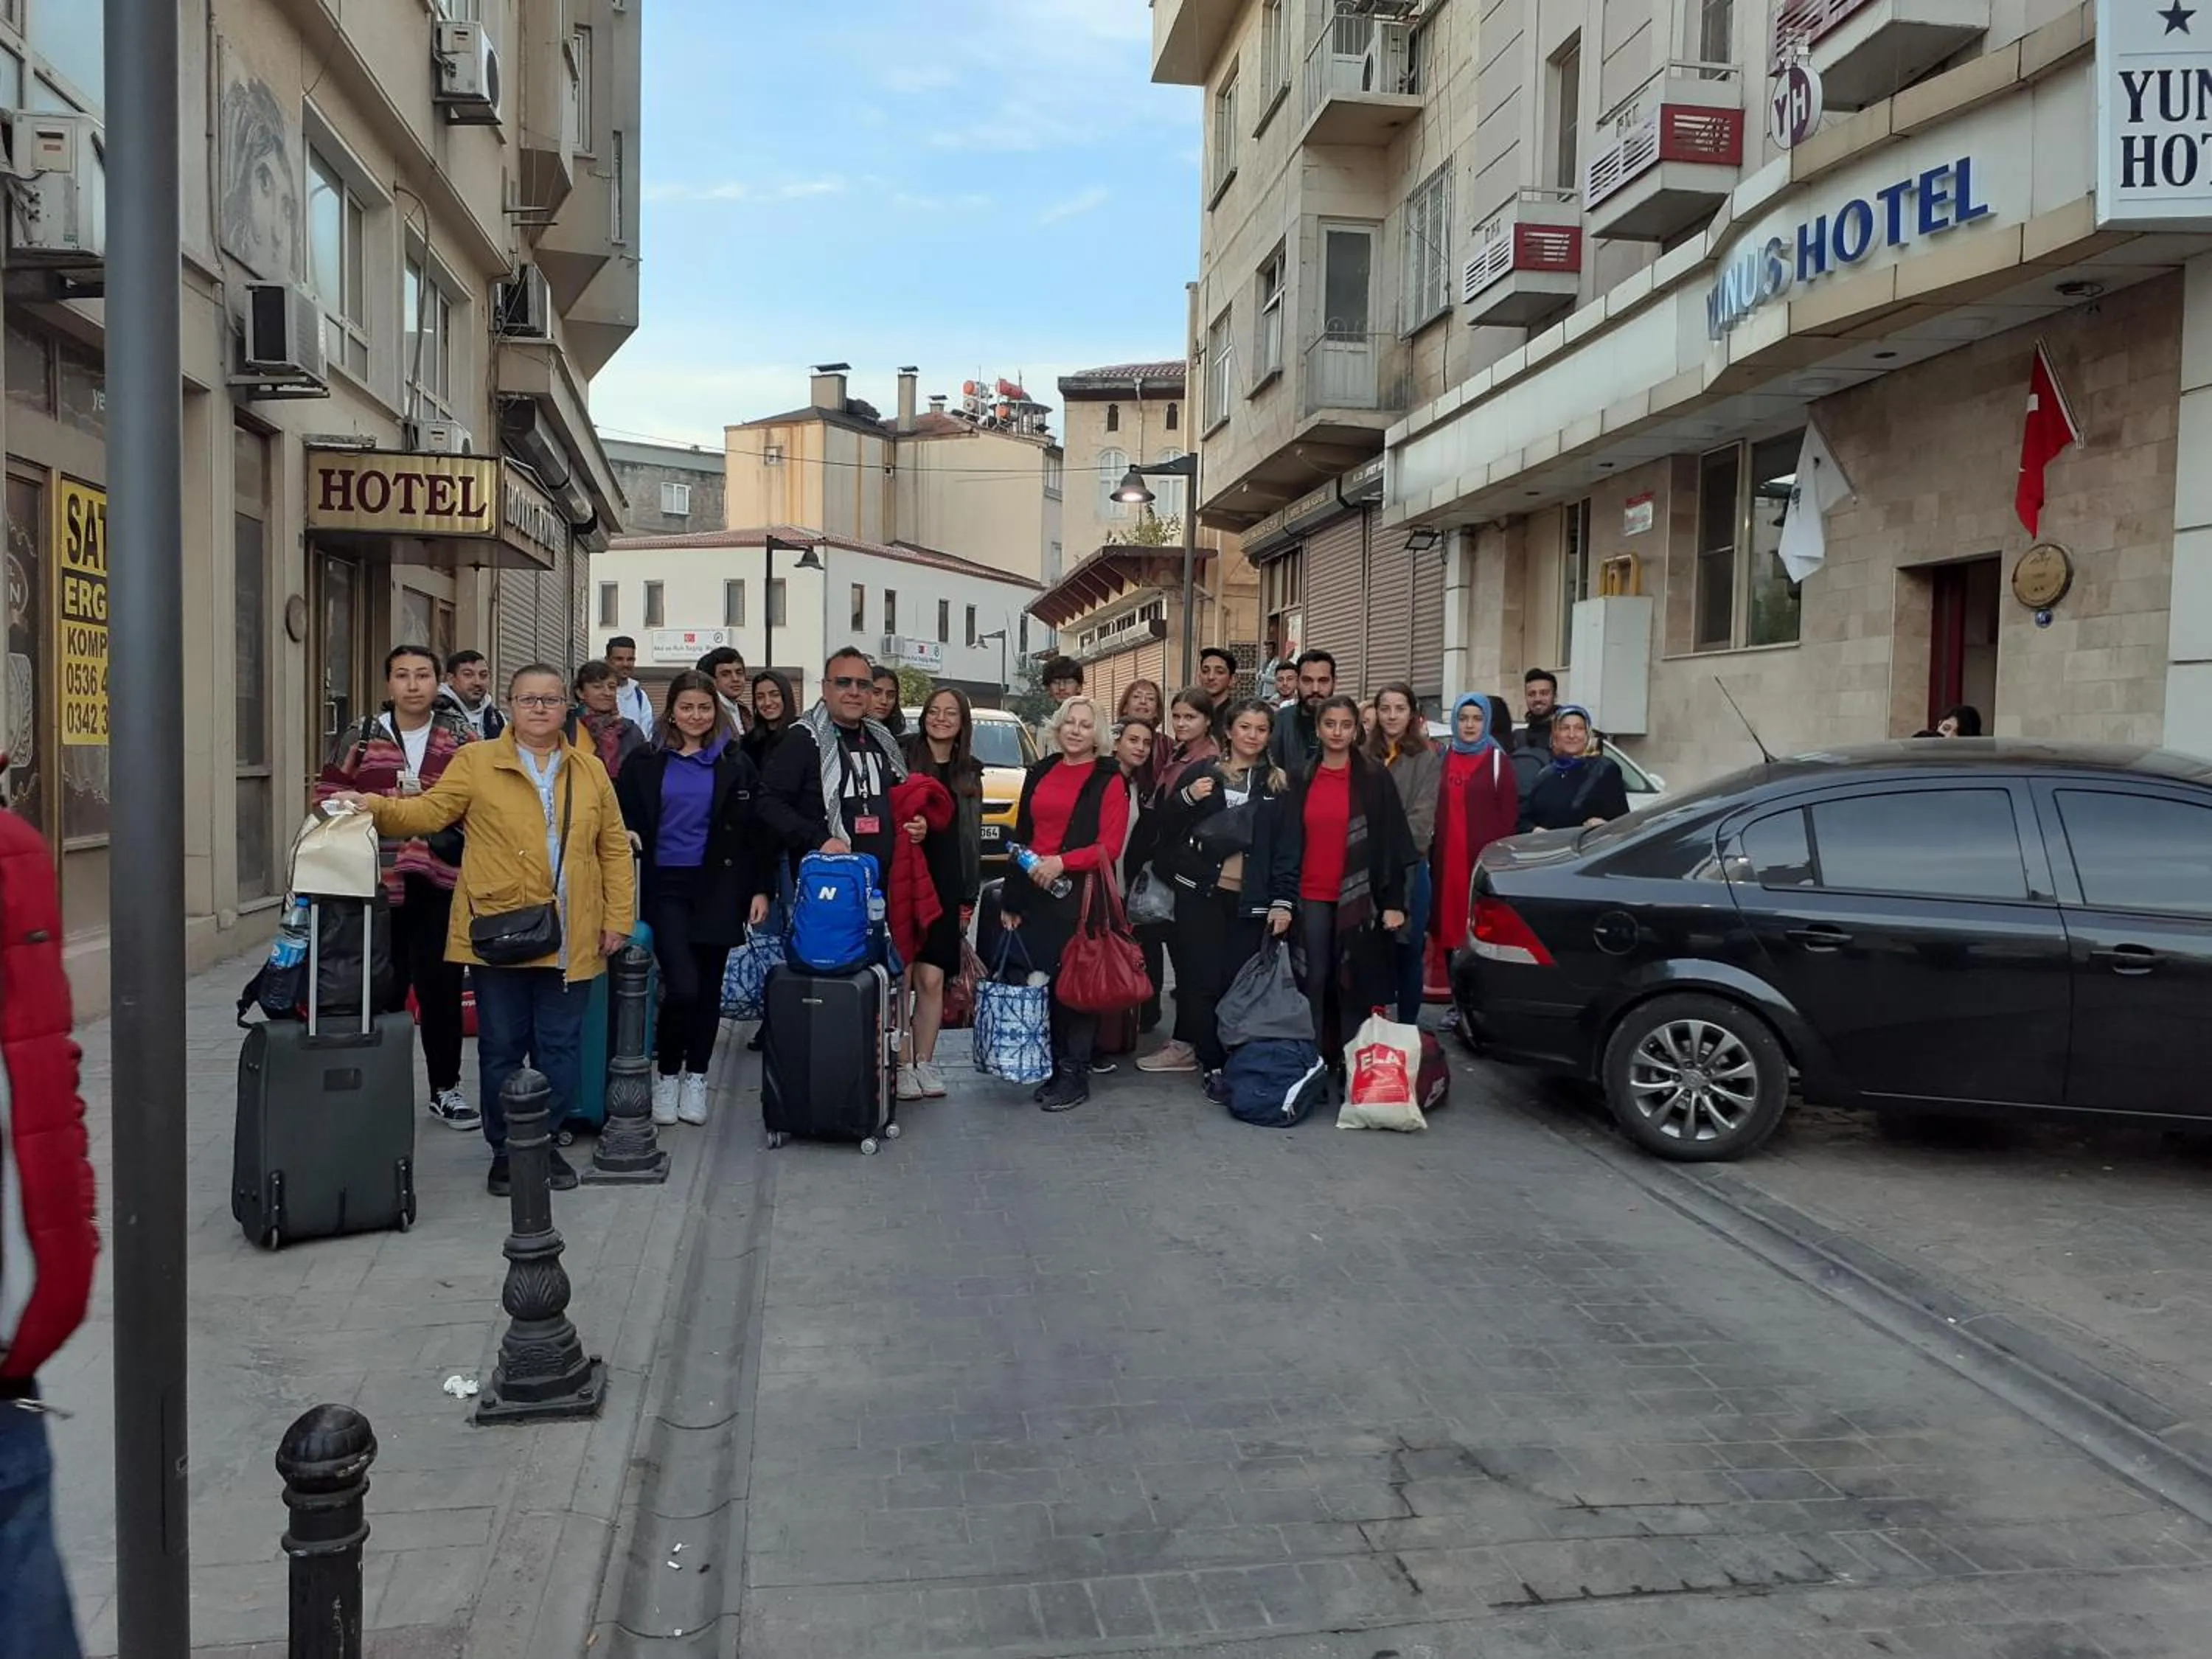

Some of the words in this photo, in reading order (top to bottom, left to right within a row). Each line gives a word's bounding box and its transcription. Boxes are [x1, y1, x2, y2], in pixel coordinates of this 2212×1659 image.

[1797, 156, 1991, 282] HOTEL
[318, 469, 487, 518] HOTEL
[65, 576, 107, 620] ERG
[67, 627, 108, 658] KOMP
[66, 662, 97, 697] 0536
[66, 701, 97, 734] 0342
[1360, 1050, 1402, 1071] ELA
